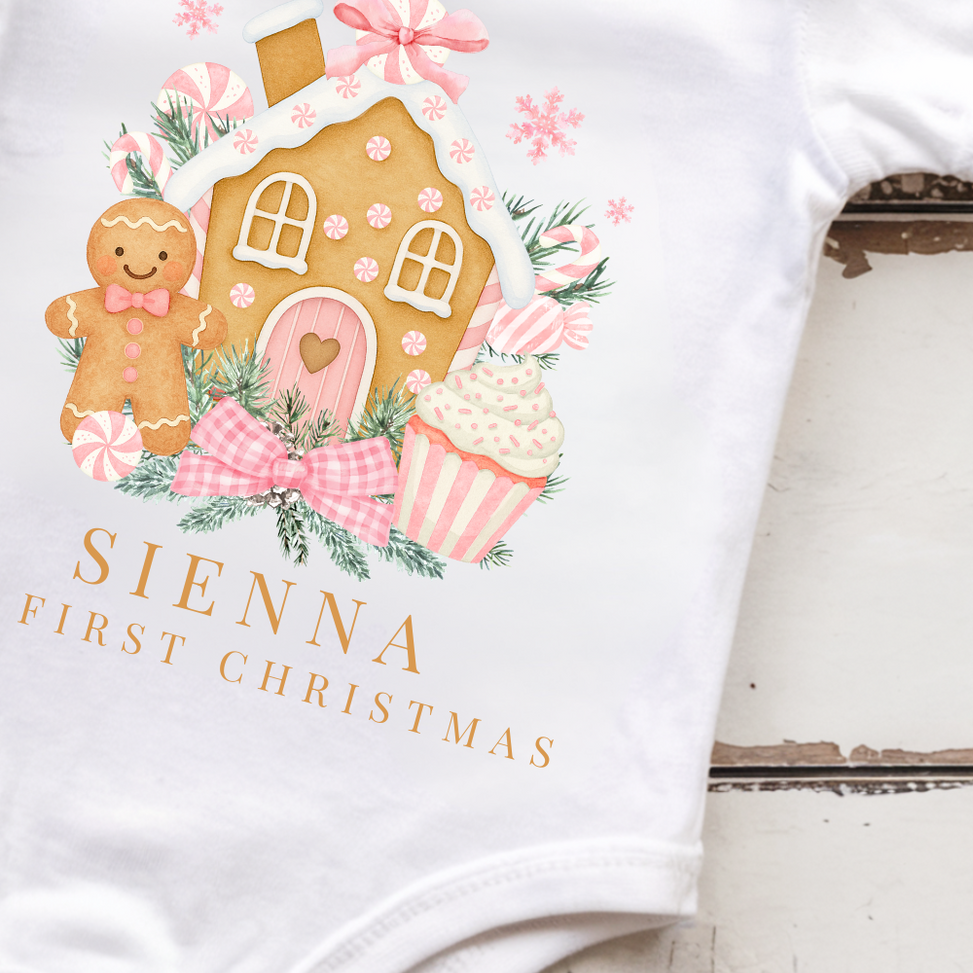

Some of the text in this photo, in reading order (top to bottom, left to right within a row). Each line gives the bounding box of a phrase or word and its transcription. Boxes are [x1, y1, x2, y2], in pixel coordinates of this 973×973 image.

[17, 592, 187, 666] FIRST
[219, 650, 555, 769] CHRISTMAS
[72, 527, 421, 675] SIENNA
